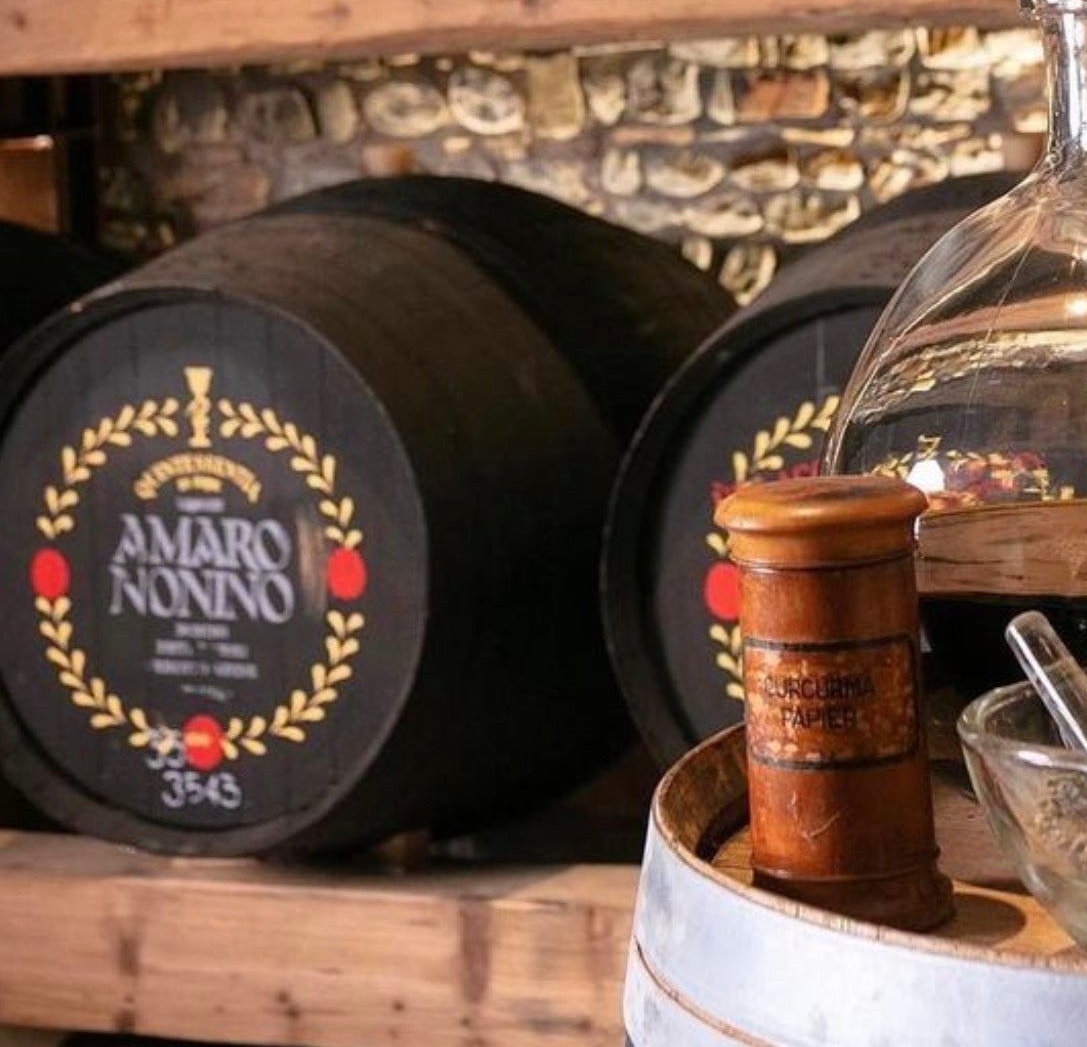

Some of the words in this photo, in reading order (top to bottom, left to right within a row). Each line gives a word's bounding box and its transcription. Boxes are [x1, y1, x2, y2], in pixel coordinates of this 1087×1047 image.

[112, 513, 292, 572] AMARO
[109, 564, 295, 624] NONINO
[161, 770, 242, 809] 3543
